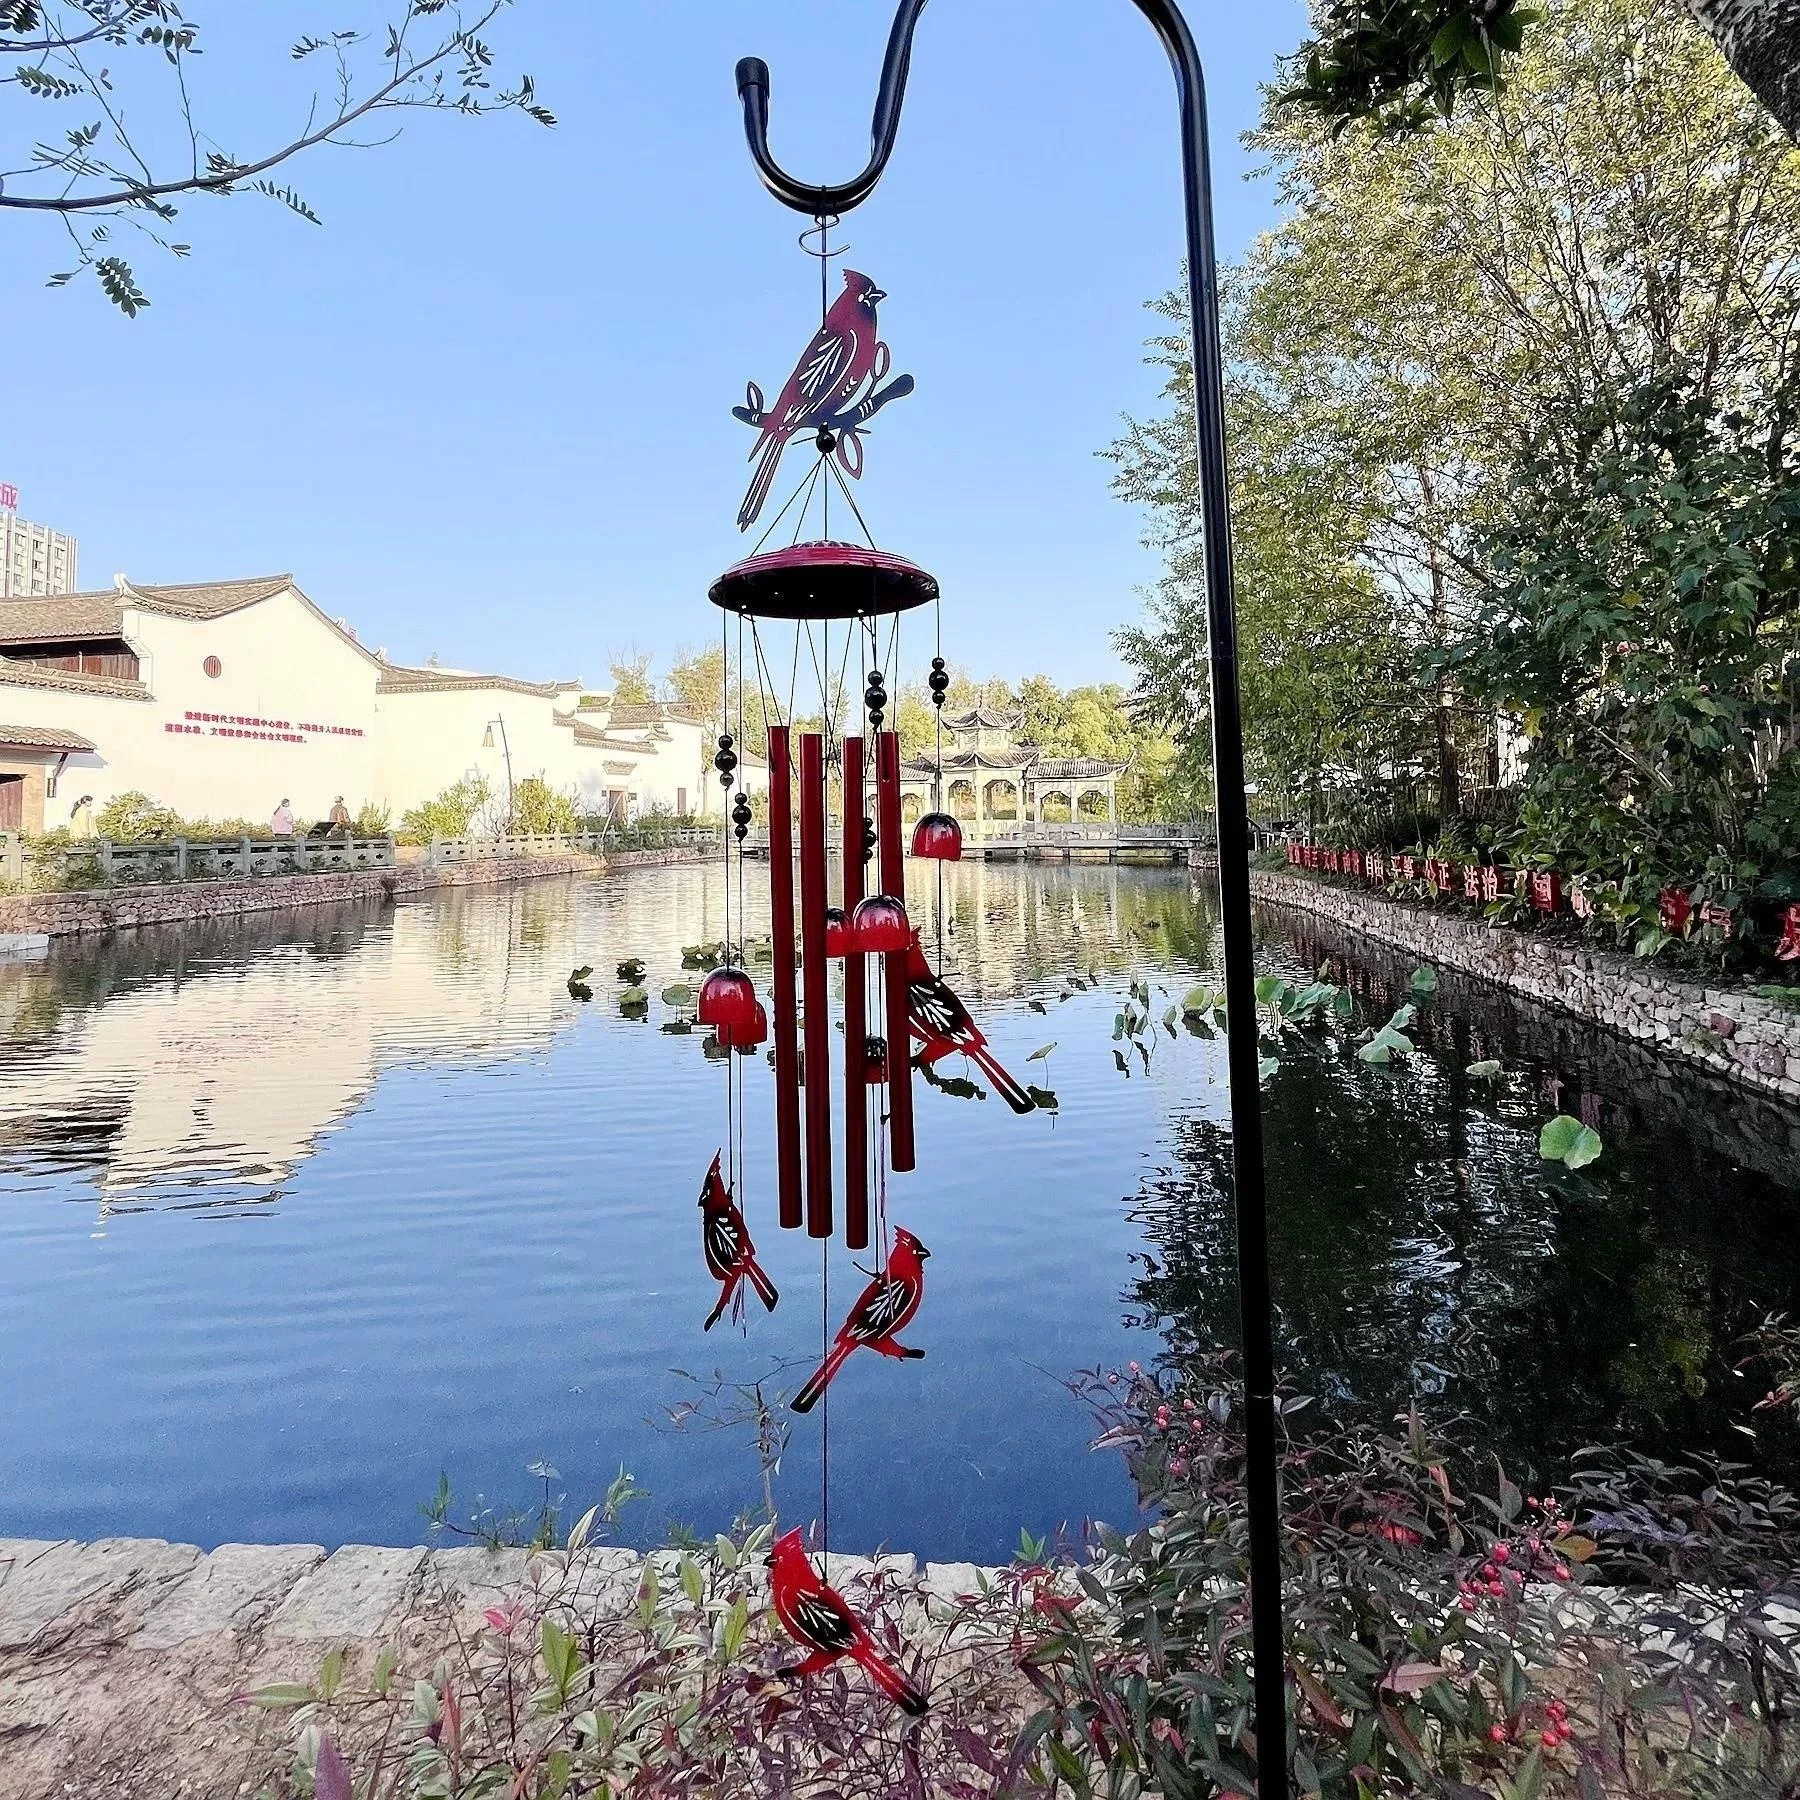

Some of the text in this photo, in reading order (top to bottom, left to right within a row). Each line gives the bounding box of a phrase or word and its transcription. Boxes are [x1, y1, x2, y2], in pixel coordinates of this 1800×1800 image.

[1365, 851, 1384, 880] 自由
[1390, 855, 1414, 881] 平等
[1424, 857, 1451, 892] 公正
[1463, 864, 1498, 902] 法治
